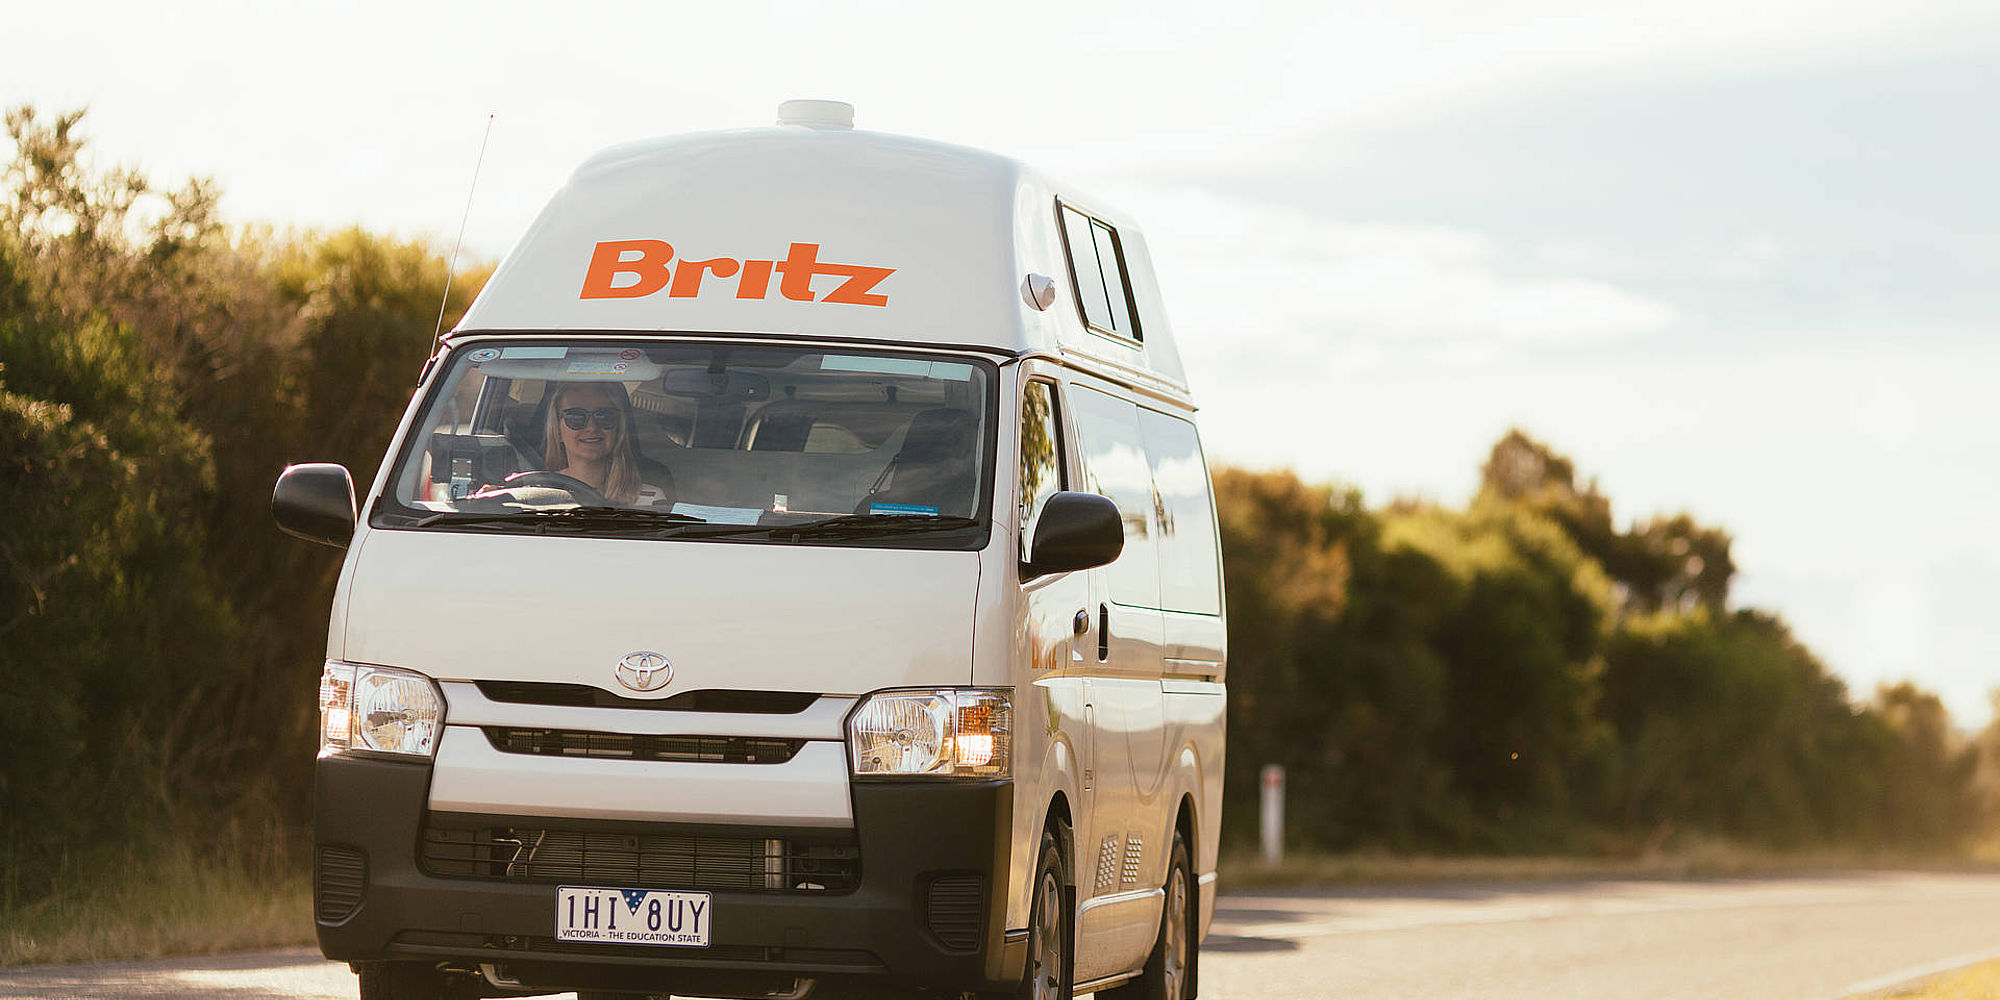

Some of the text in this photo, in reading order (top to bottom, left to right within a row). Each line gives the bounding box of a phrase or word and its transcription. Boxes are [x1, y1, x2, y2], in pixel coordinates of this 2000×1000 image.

[579, 239, 897, 307] Britz
[567, 895, 706, 933] 1HI 8UY
[562, 929, 600, 938] VICTORIA
[608, 931, 624, 940] THE
[626, 932, 675, 942] EDUCATION
[677, 934, 701, 943] STATE
